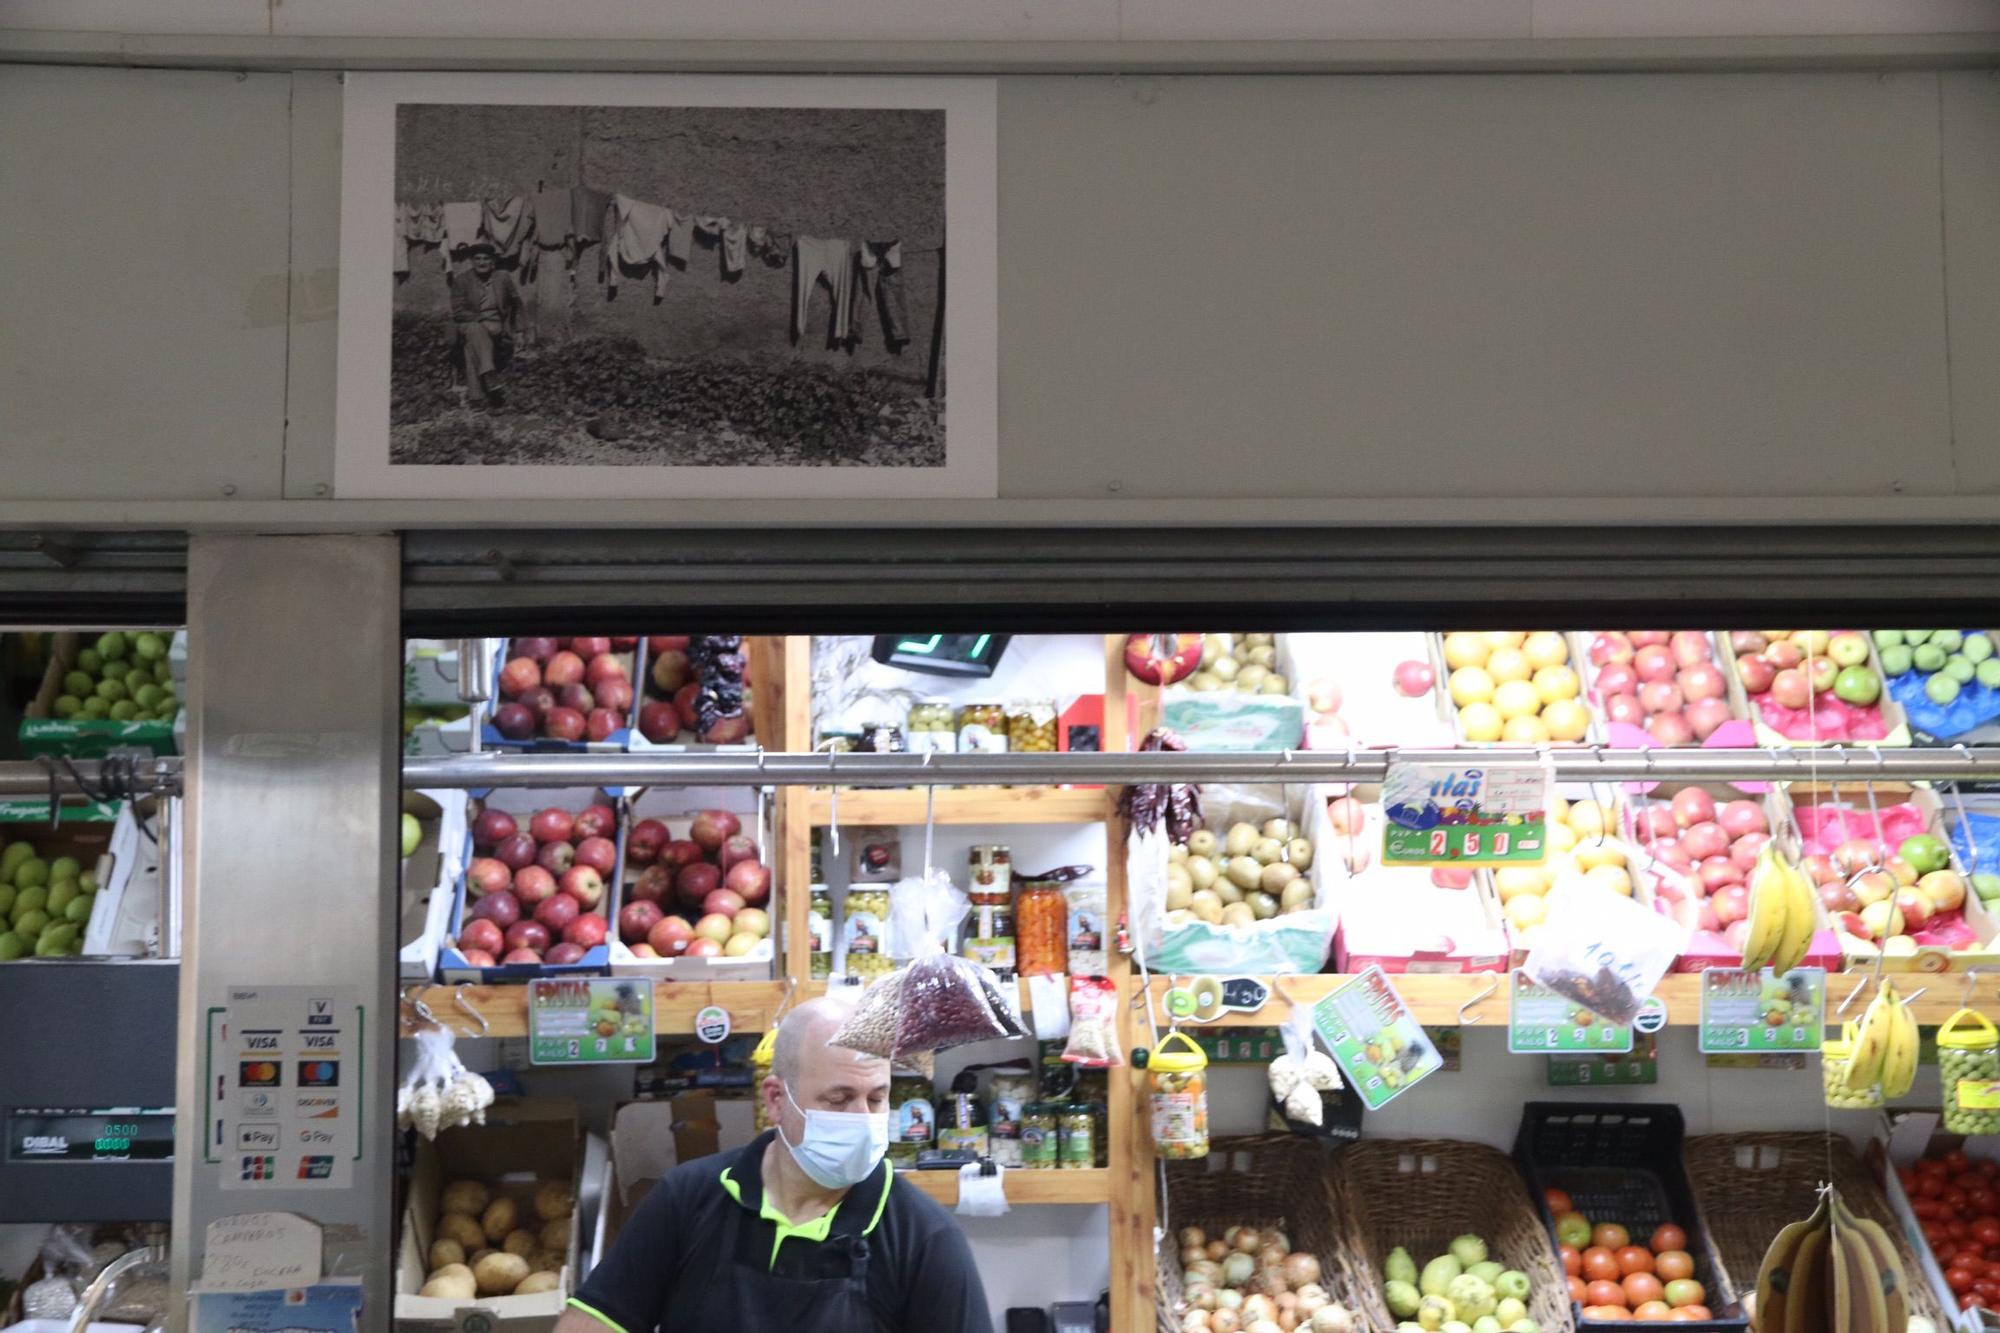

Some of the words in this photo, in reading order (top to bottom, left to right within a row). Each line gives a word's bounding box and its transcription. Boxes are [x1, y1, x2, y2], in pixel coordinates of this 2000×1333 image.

[1429, 772, 1482, 797] utas
[248, 1037, 278, 1048] VISA
[305, 1036, 335, 1047] VISA
[253, 1132, 274, 1144] Pay
